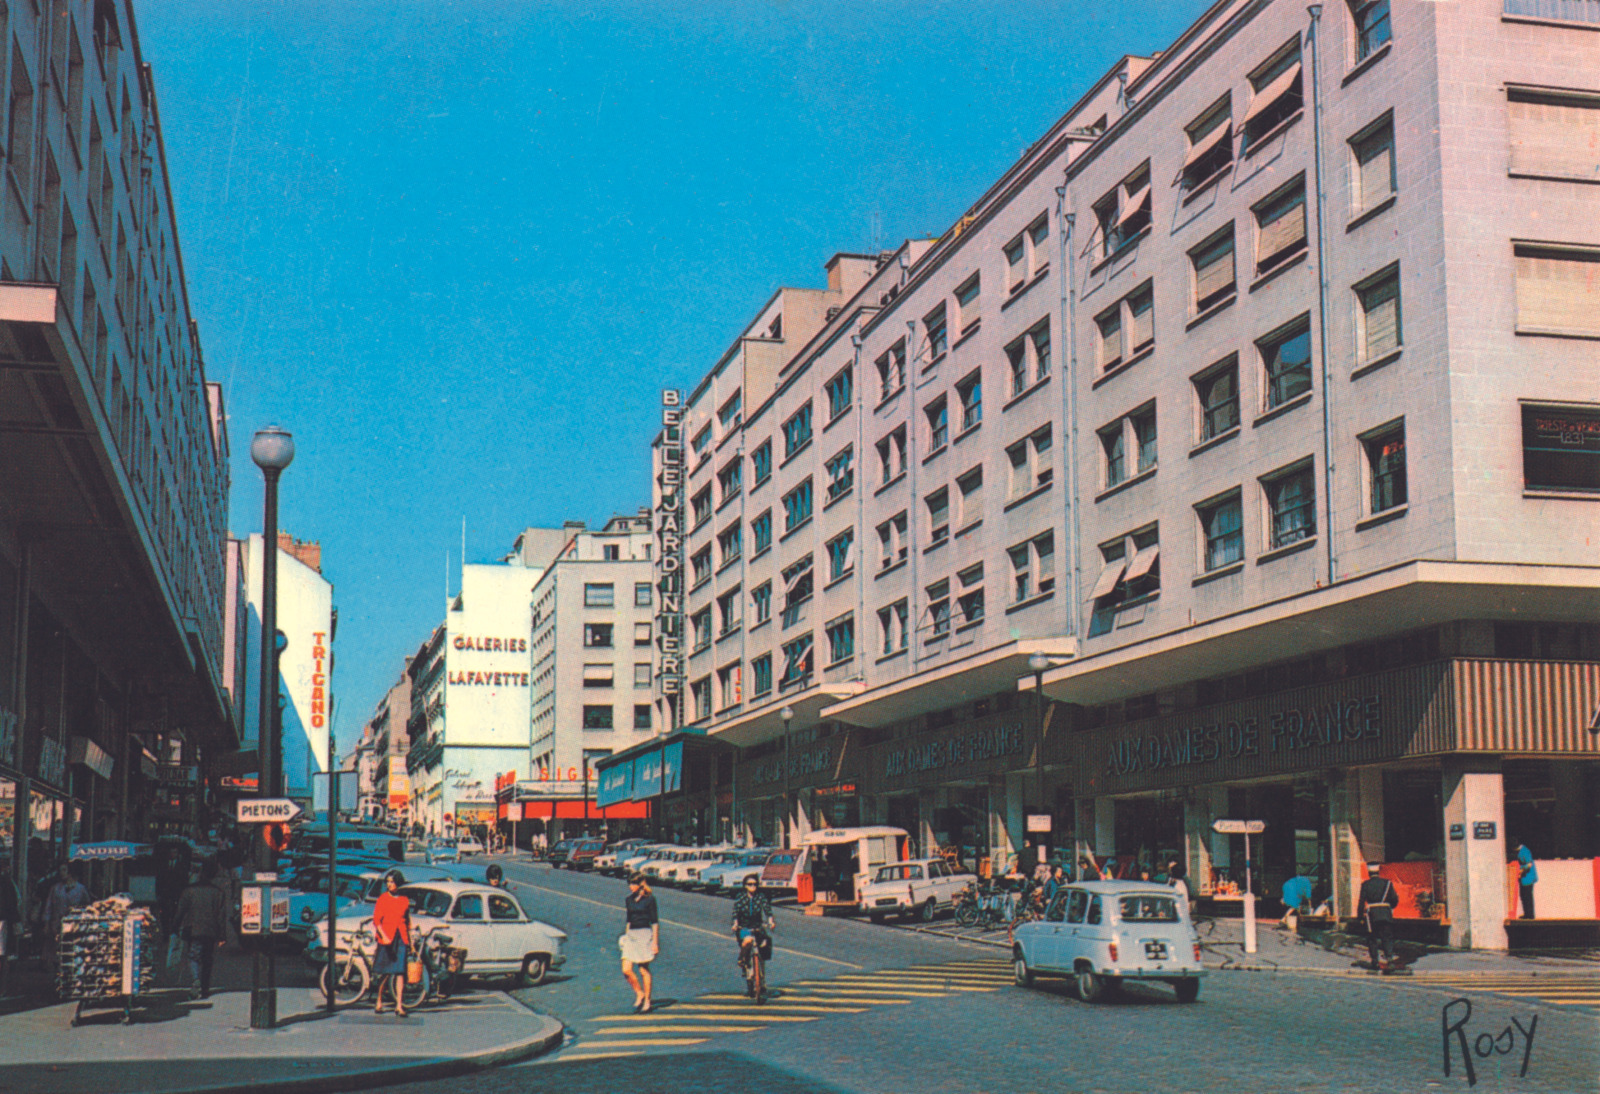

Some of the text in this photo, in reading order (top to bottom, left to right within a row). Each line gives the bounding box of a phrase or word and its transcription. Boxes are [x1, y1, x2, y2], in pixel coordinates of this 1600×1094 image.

[662, 389, 680, 485] BELLE
[453, 635, 527, 653] GALERIES
[311, 631, 326, 728] TRIGANO
[448, 670, 529, 687] LAFAYETTE
[908, 741, 947, 772] DAMES
[949, 735, 966, 765] DE
[970, 722, 1023, 761] FRANCE
[1106, 695, 1381, 775] AUX DAMES DE FRANCE
